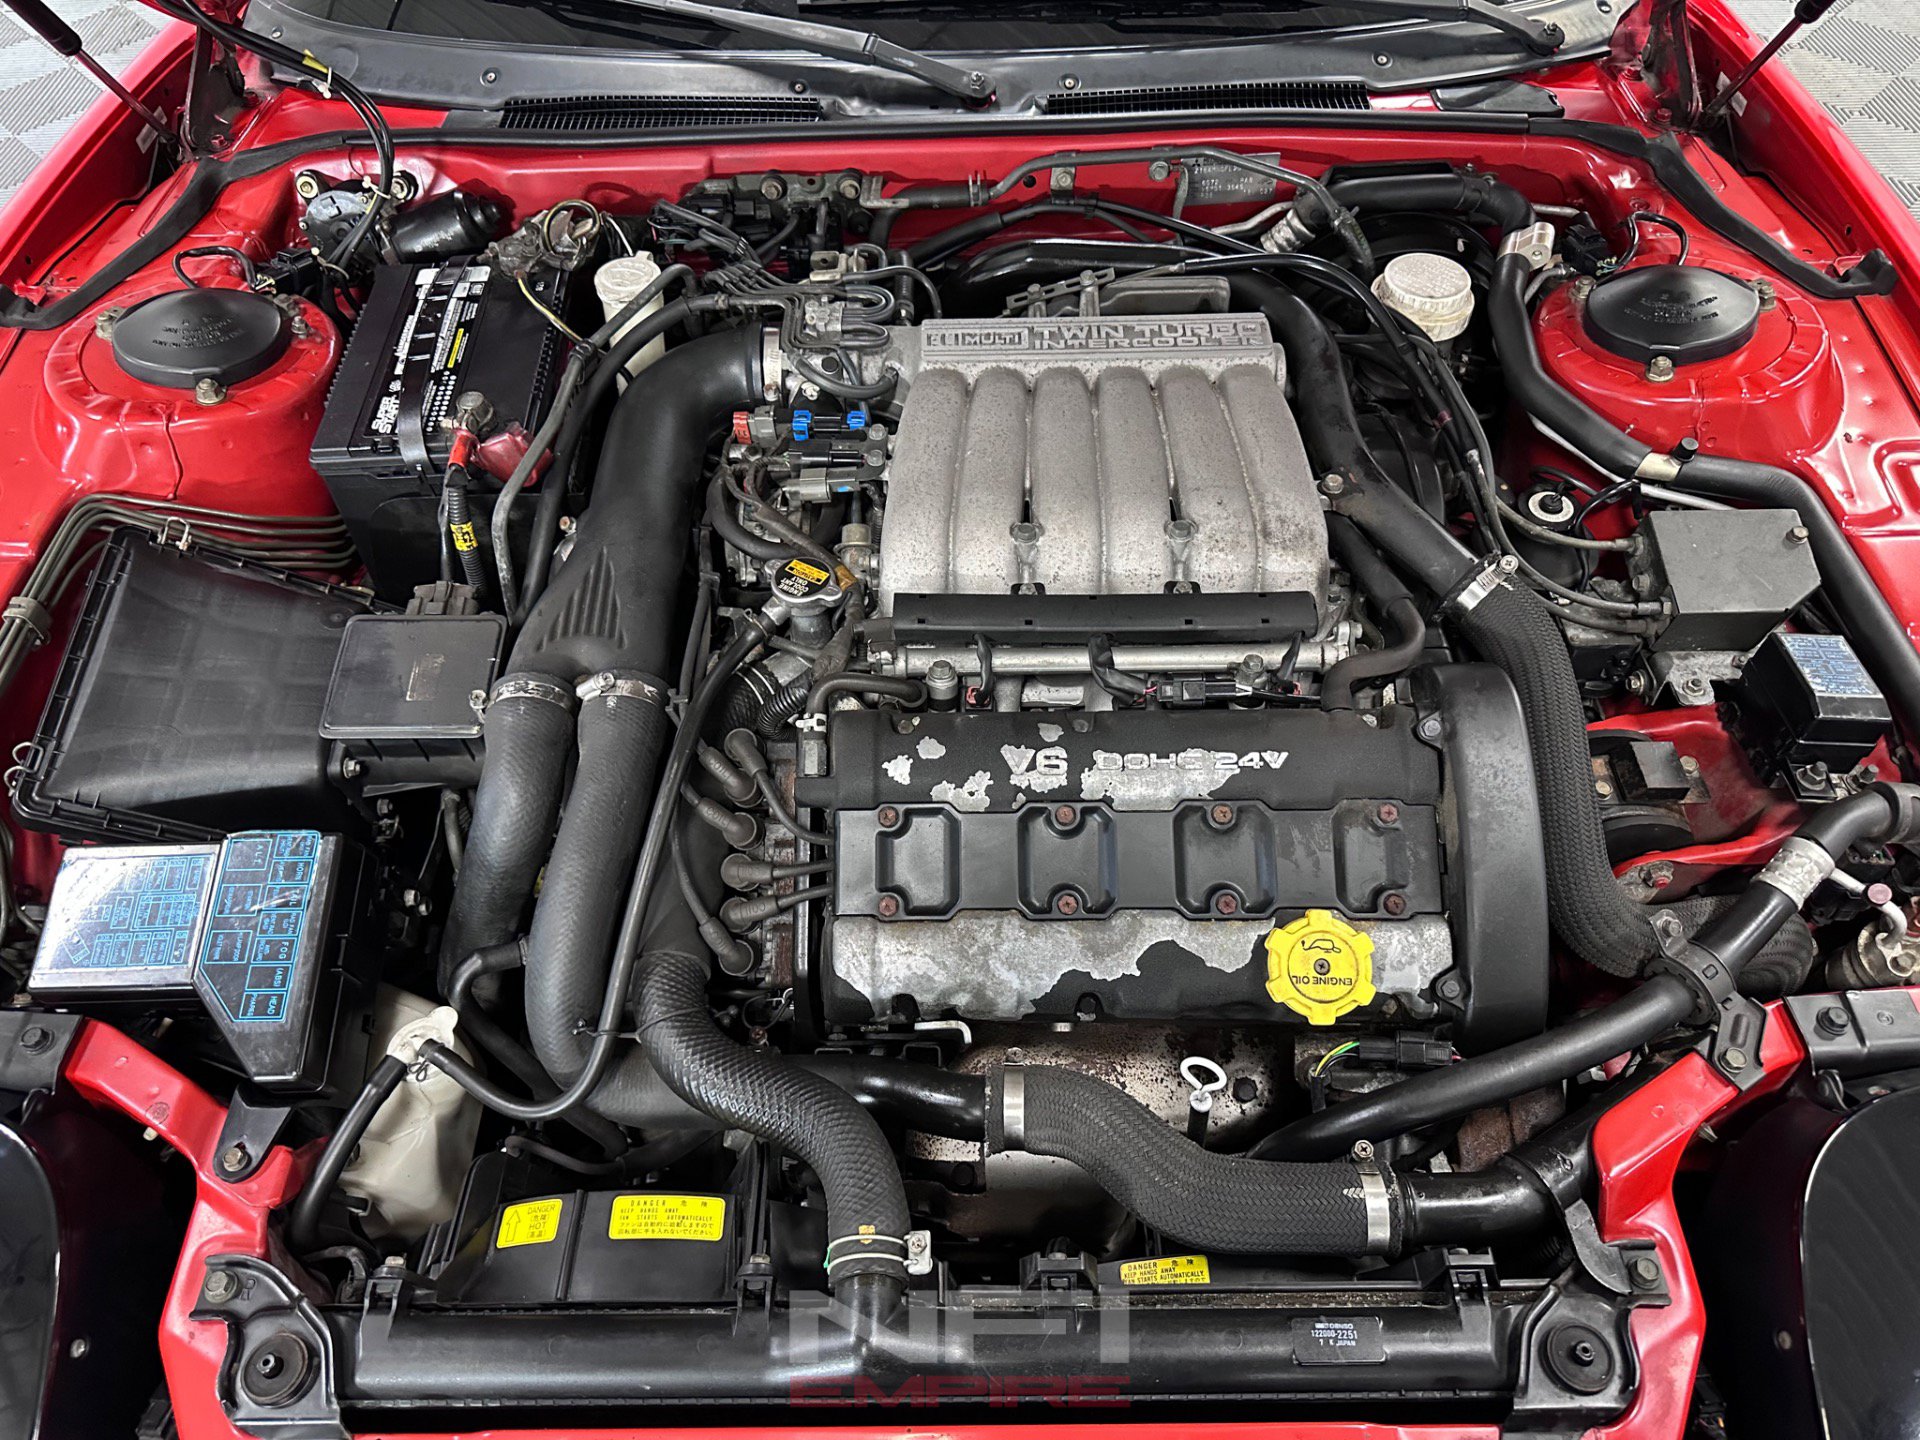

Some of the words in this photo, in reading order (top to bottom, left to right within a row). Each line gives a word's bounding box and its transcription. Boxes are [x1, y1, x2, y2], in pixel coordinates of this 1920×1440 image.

[1033, 325, 1124, 339] TWIN
[1134, 322, 1263, 338] TURBO
[962, 332, 1020, 346] MULTI
[1034, 336, 1264, 350] INTERCOOLER
[372, 396, 392, 430] SUPER
[378, 396, 400, 434] START
[781, 578, 809, 592] COOLANT
[791, 576, 808, 586] ONLY
[778, 582, 803, 596] ENGINE
[1000, 749, 1068, 776] V6
[1096, 752, 1204, 770] DOHC
[1214, 751, 1288, 770] 24V
[295, 862, 304, 880] HORN
[279, 941, 289, 959] FOG
[273, 968, 284, 987] (ABS)
[1292, 976, 1310, 984] OIL
[1312, 976, 1352, 986] ENGINE
[267, 996, 277, 1014] HEAD
[528, 1204, 555, 1214] DANGER
[1128, 1262, 1157, 1271] DANGER
[1311, 1330, 1358, 1339] 122000-2251
